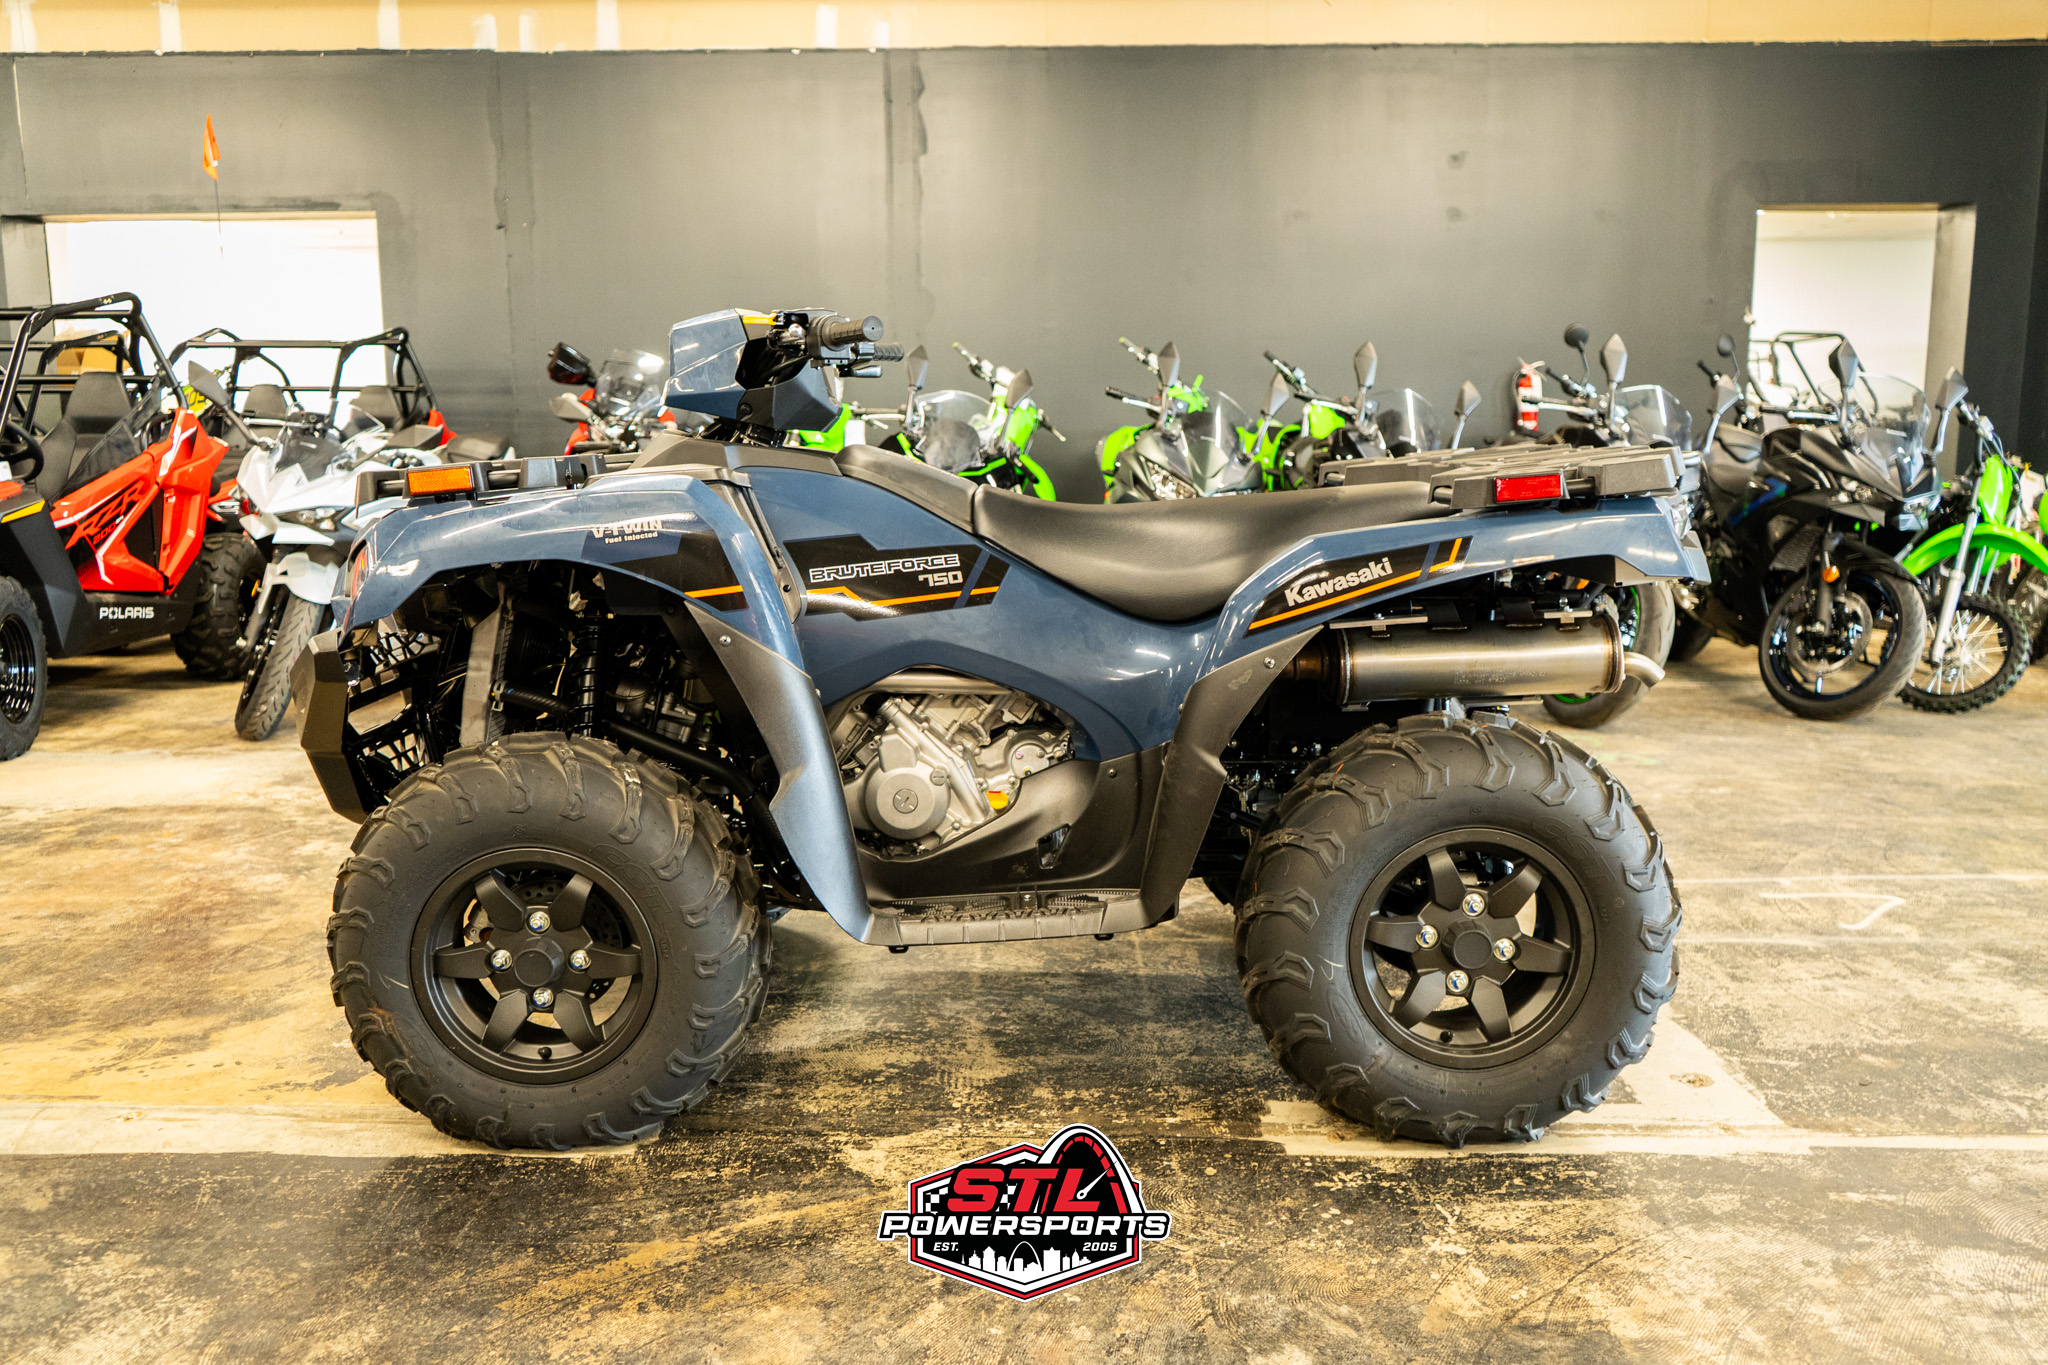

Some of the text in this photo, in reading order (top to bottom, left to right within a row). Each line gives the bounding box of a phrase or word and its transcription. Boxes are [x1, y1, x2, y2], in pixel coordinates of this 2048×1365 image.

[64, 479, 145, 550] RZR
[92, 521, 118, 546] 200
[591, 520, 663, 539] V-TWIN
[918, 570, 963, 587] 750
[1284, 556, 1393, 607] Kawasaki
[98, 606, 155, 620] POLARIS
